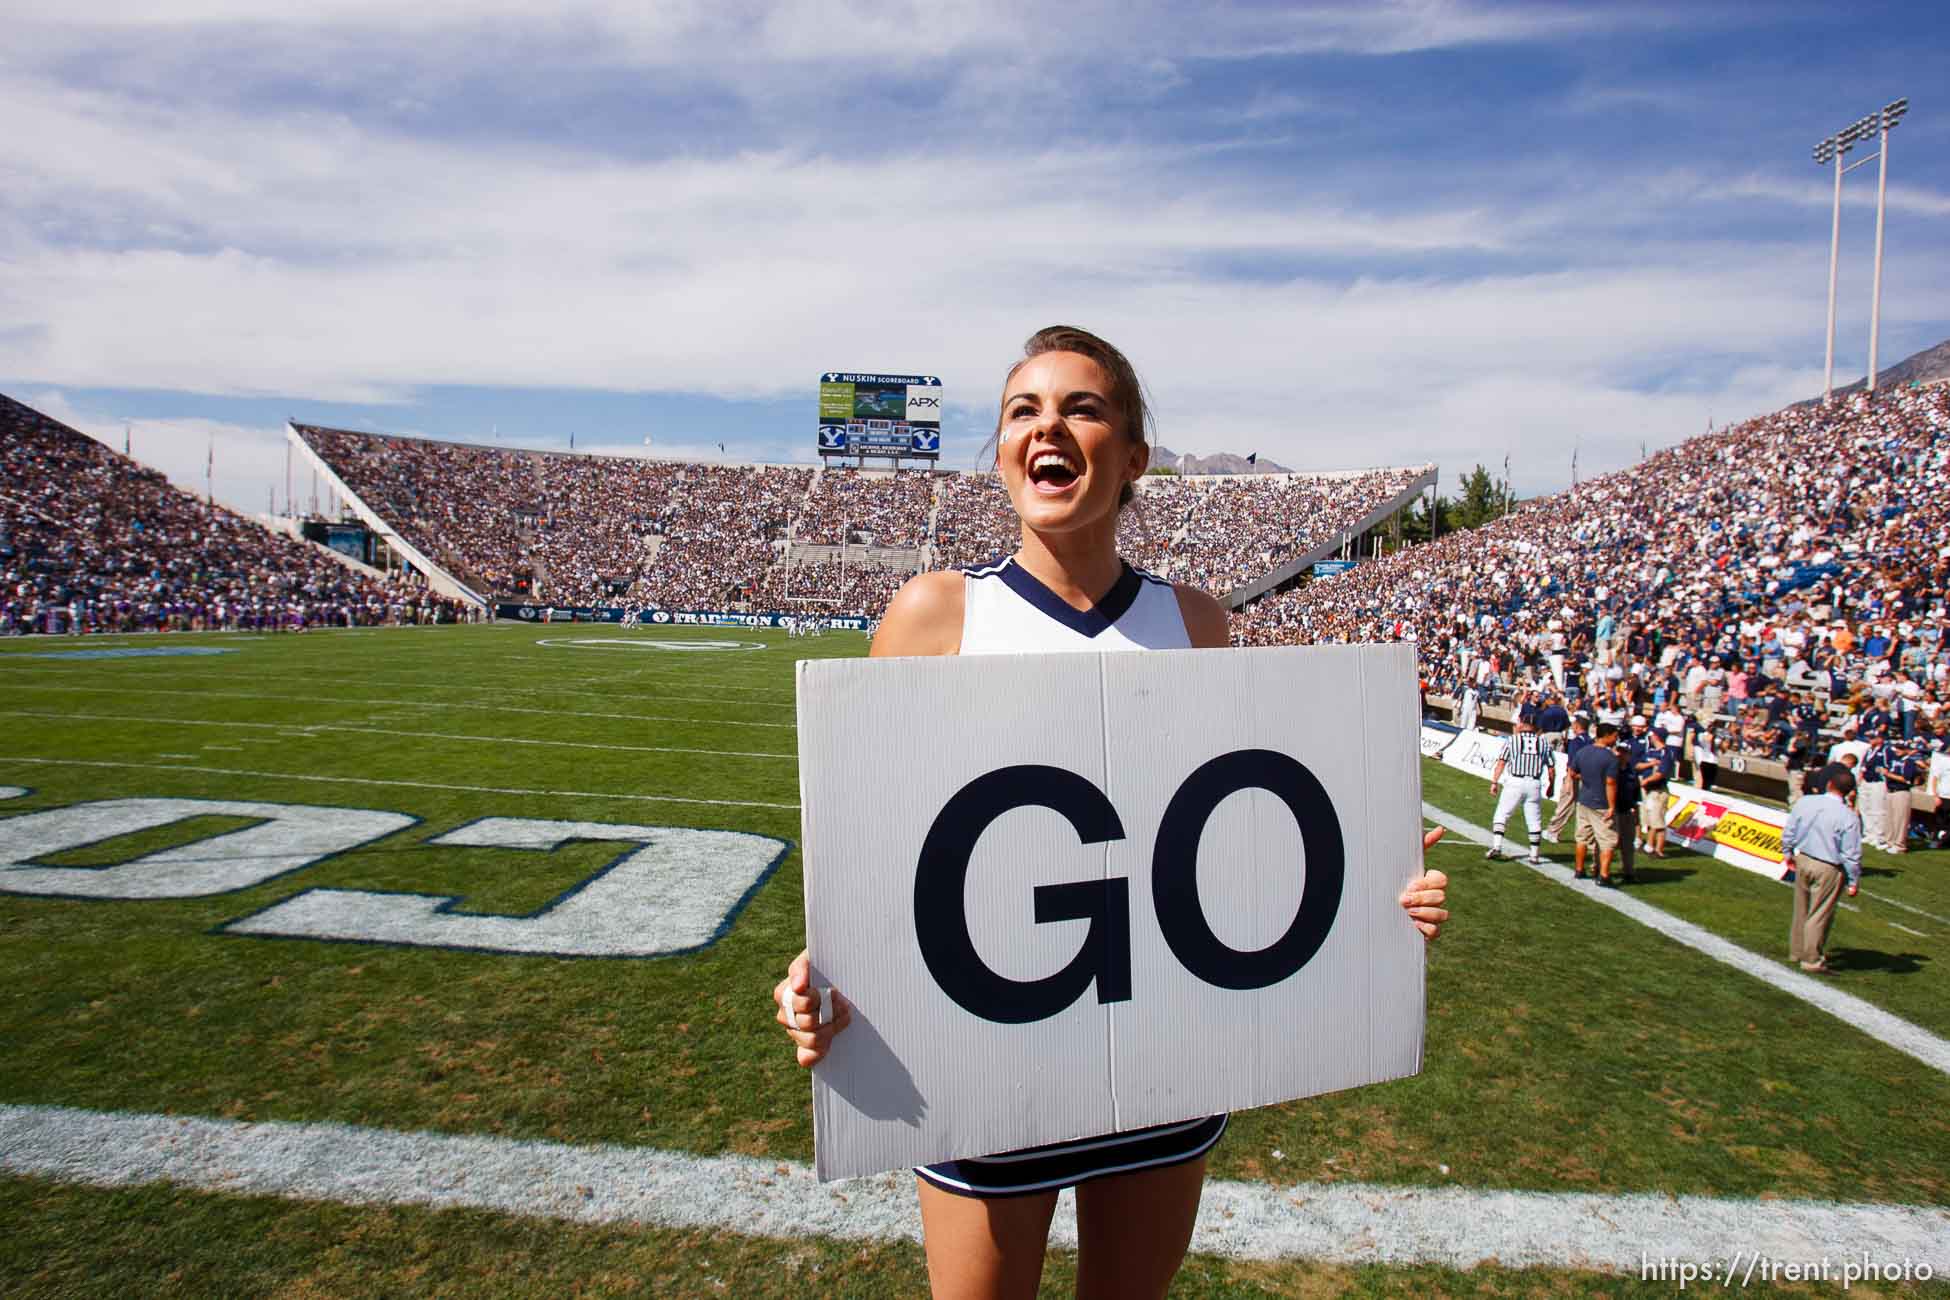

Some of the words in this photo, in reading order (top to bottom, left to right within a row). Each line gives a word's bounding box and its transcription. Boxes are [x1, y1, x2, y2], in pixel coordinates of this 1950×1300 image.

[908, 397, 939, 408] APX
[1731, 825, 1785, 854] SCHWA
[913, 748, 1346, 1025] GO
